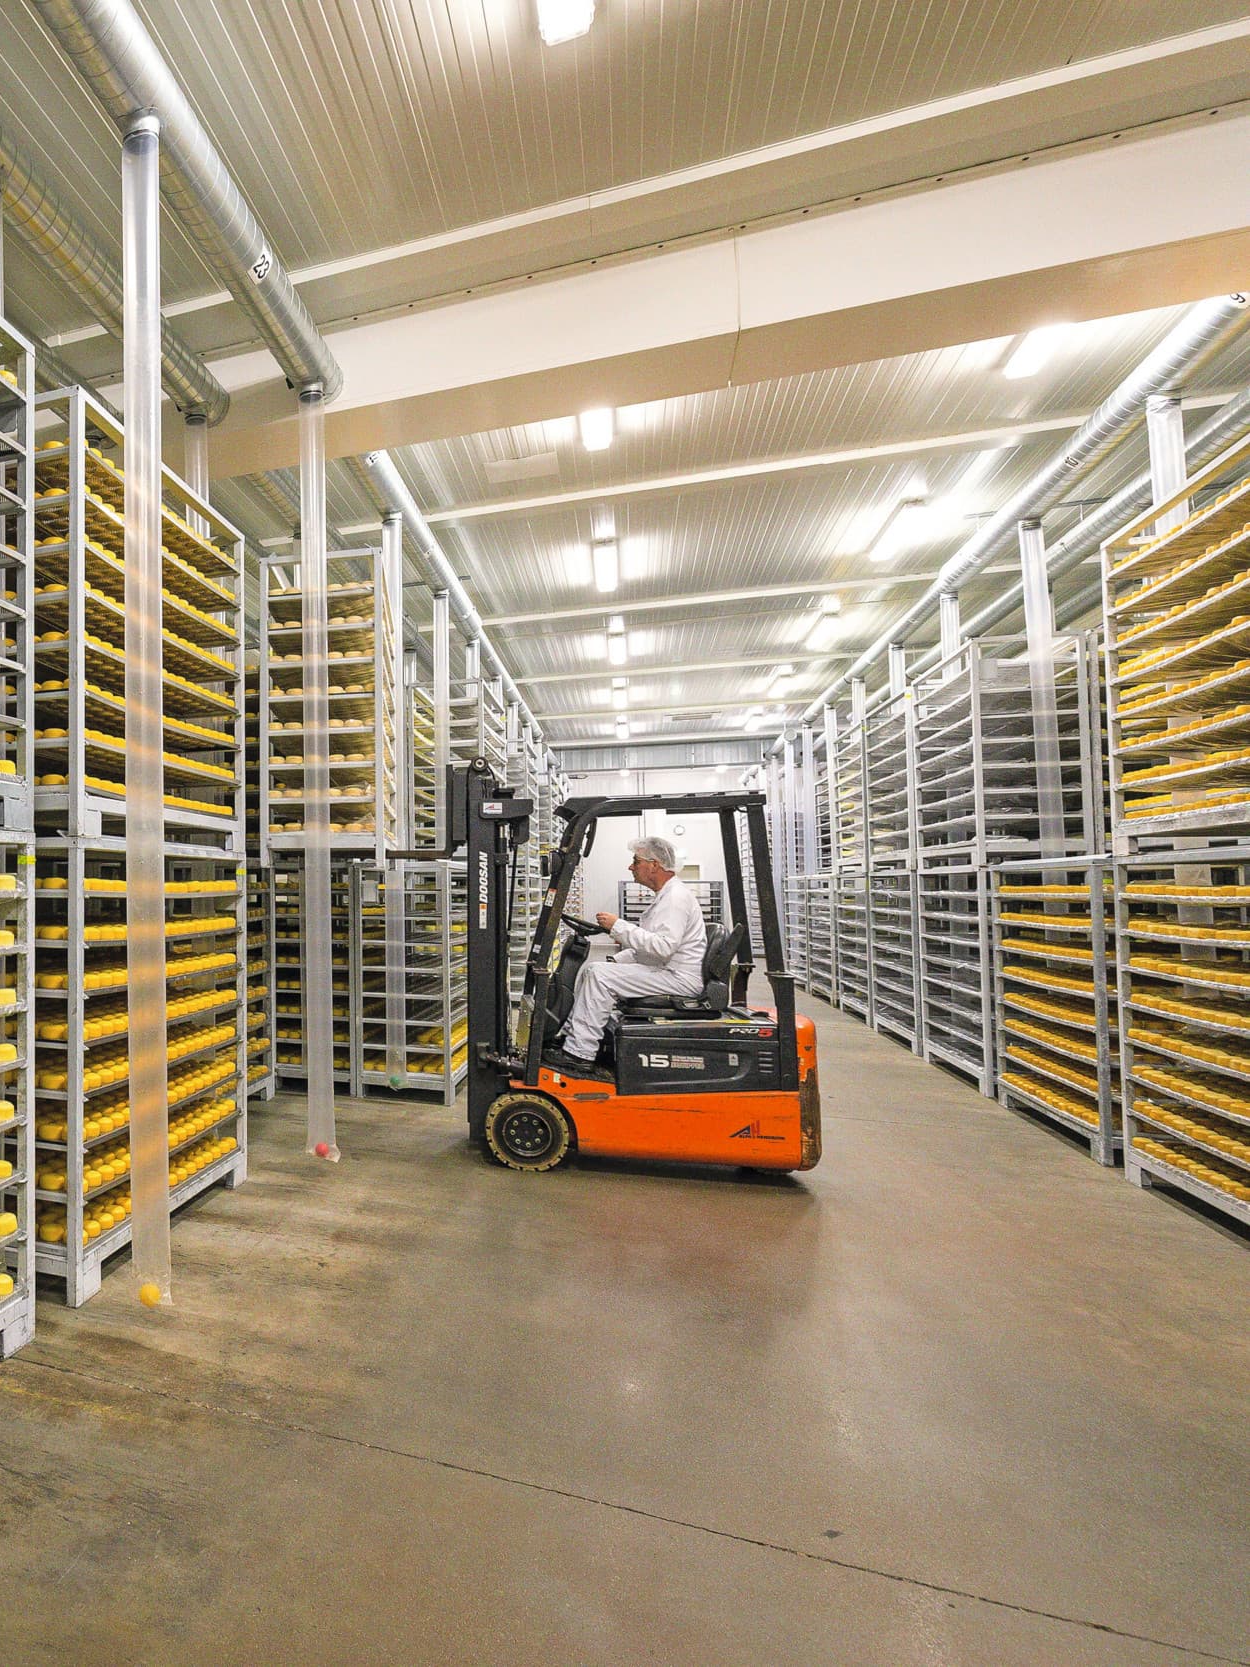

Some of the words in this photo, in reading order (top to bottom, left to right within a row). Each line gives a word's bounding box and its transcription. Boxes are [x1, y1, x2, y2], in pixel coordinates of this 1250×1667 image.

[253, 254, 270, 279] 23
[479, 851, 489, 904] DOOSAN
[638, 1053, 671, 1068] 15
